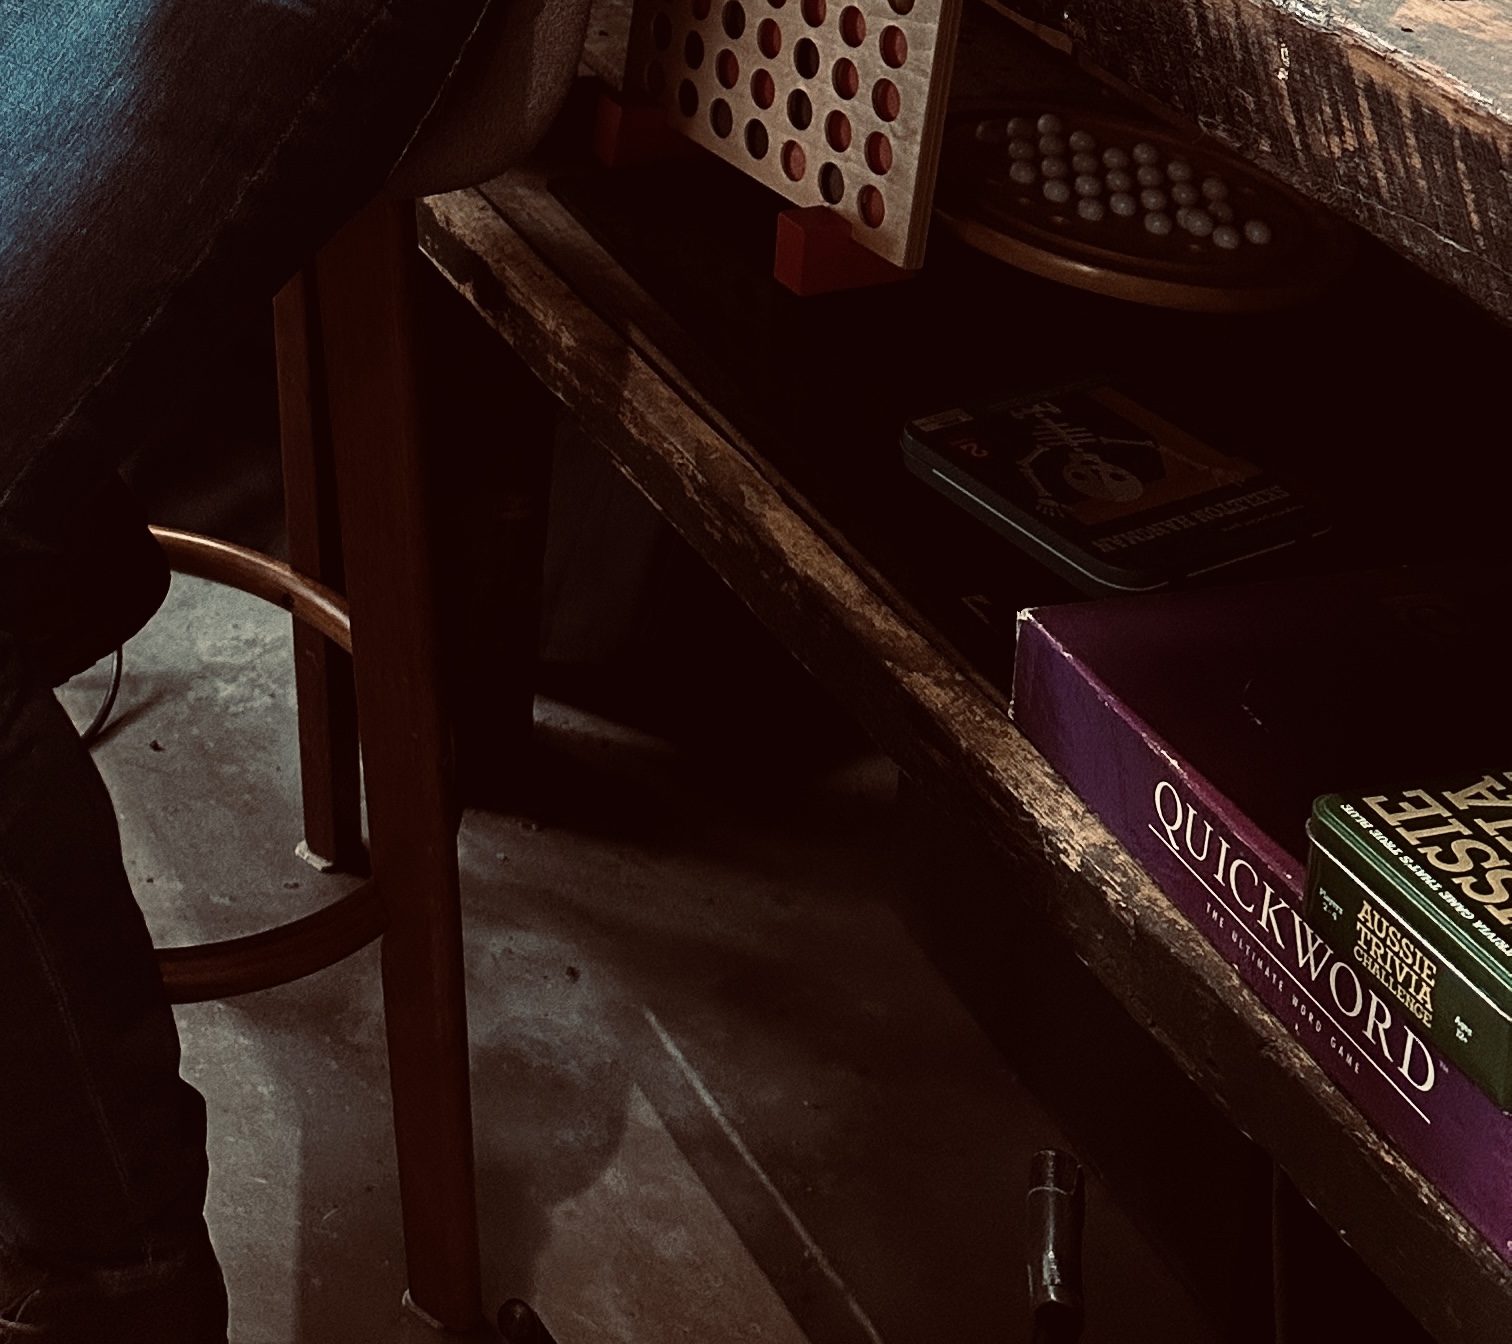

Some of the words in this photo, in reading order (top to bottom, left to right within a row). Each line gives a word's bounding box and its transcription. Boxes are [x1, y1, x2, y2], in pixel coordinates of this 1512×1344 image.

[1340, 803, 1374, 829] BLUE
[1362, 788, 1512, 926] SSIE
[1369, 828, 1404, 856] TRUE
[1398, 855, 1443, 891] THAT'S
[1438, 890, 1475, 921] GAME
[1153, 780, 1436, 1093] QUICKWORD
[1356, 920, 1434, 1013] TRIVIA
[1357, 899, 1437, 988] AUSSIE
[1205, 901, 1225, 930] THE
[1231, 929, 1284, 993] ULTIMATE
[1291, 994, 1322, 1034] WORD
[1330, 1035, 1360, 1075] GAME
[1353, 945, 1433, 1029] CHALLENGE
